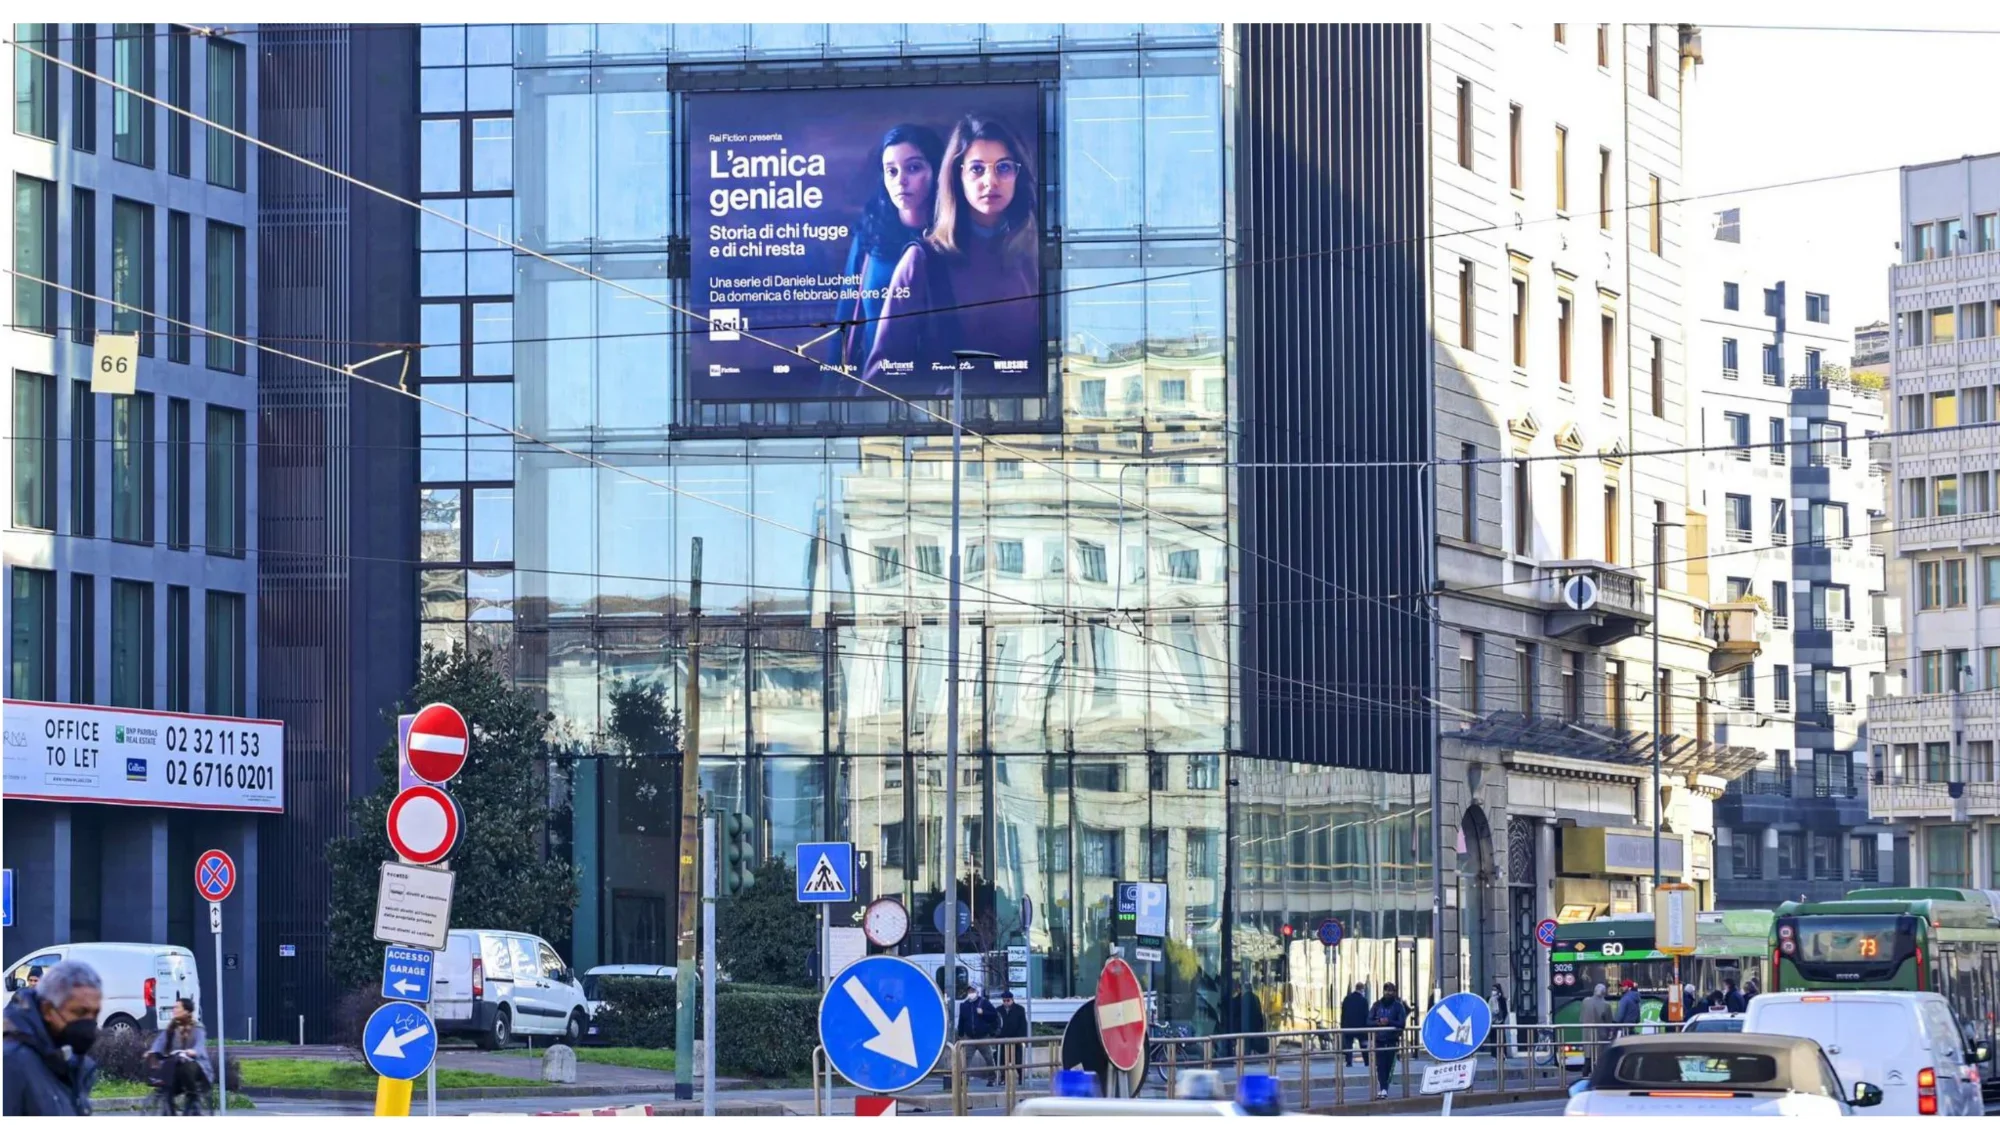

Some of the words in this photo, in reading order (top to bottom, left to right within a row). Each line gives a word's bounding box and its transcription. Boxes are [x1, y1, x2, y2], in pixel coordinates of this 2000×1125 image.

[709, 134, 721, 142] Rai
[722, 133, 748, 142] Fiction
[749, 132, 783, 143] presenta
[710, 148, 826, 178] L'amica
[709, 180, 823, 217] geniale
[709, 224, 757, 240] Storia
[759, 224, 774, 239] di
[776, 223, 800, 238] chi
[802, 223, 848, 241] fugge
[709, 246, 720, 257] e
[722, 242, 737, 257] di
[739, 242, 762, 256] chi
[765, 243, 805, 256] resta
[709, 276, 732, 288] Una
[733, 276, 761, 288] serie
[762, 275, 773, 287] di
[774, 275, 816, 287] Daniele
[817, 274, 862, 286] Luchetti
[709, 290, 726, 302] Da
[727, 289, 782, 302] domenica
[783, 289, 791, 301] 6
[793, 288, 839, 300] febbraio
[840, 288, 860, 300] alle
[861, 289, 879, 299] ore
[881, 286, 911, 299] 2.25
[741, 317, 749, 332] 1
[101, 355, 128, 373] 66
[45, 719, 100, 742] OFFICE
[166, 726, 187, 752] 02
[193, 728, 213, 754] 32
[219, 730, 234, 755] 11
[240, 732, 260, 757] 53
[46, 746, 66, 767] TO
[74, 747, 99, 768] LET
[166, 760, 187, 785] 02
[193, 762, 233, 788] 6716
[237, 764, 274, 790] 0201
[1141, 886, 1162, 916] P
[1602, 942, 1624, 956] 60
[1859, 938, 1877, 956] 73
[388, 951, 430, 963] ACCESSO
[390, 964, 426, 976] GARAGE
[1554, 963, 1573, 972] 3026
[1434, 1064, 1467, 1076] eccetto
